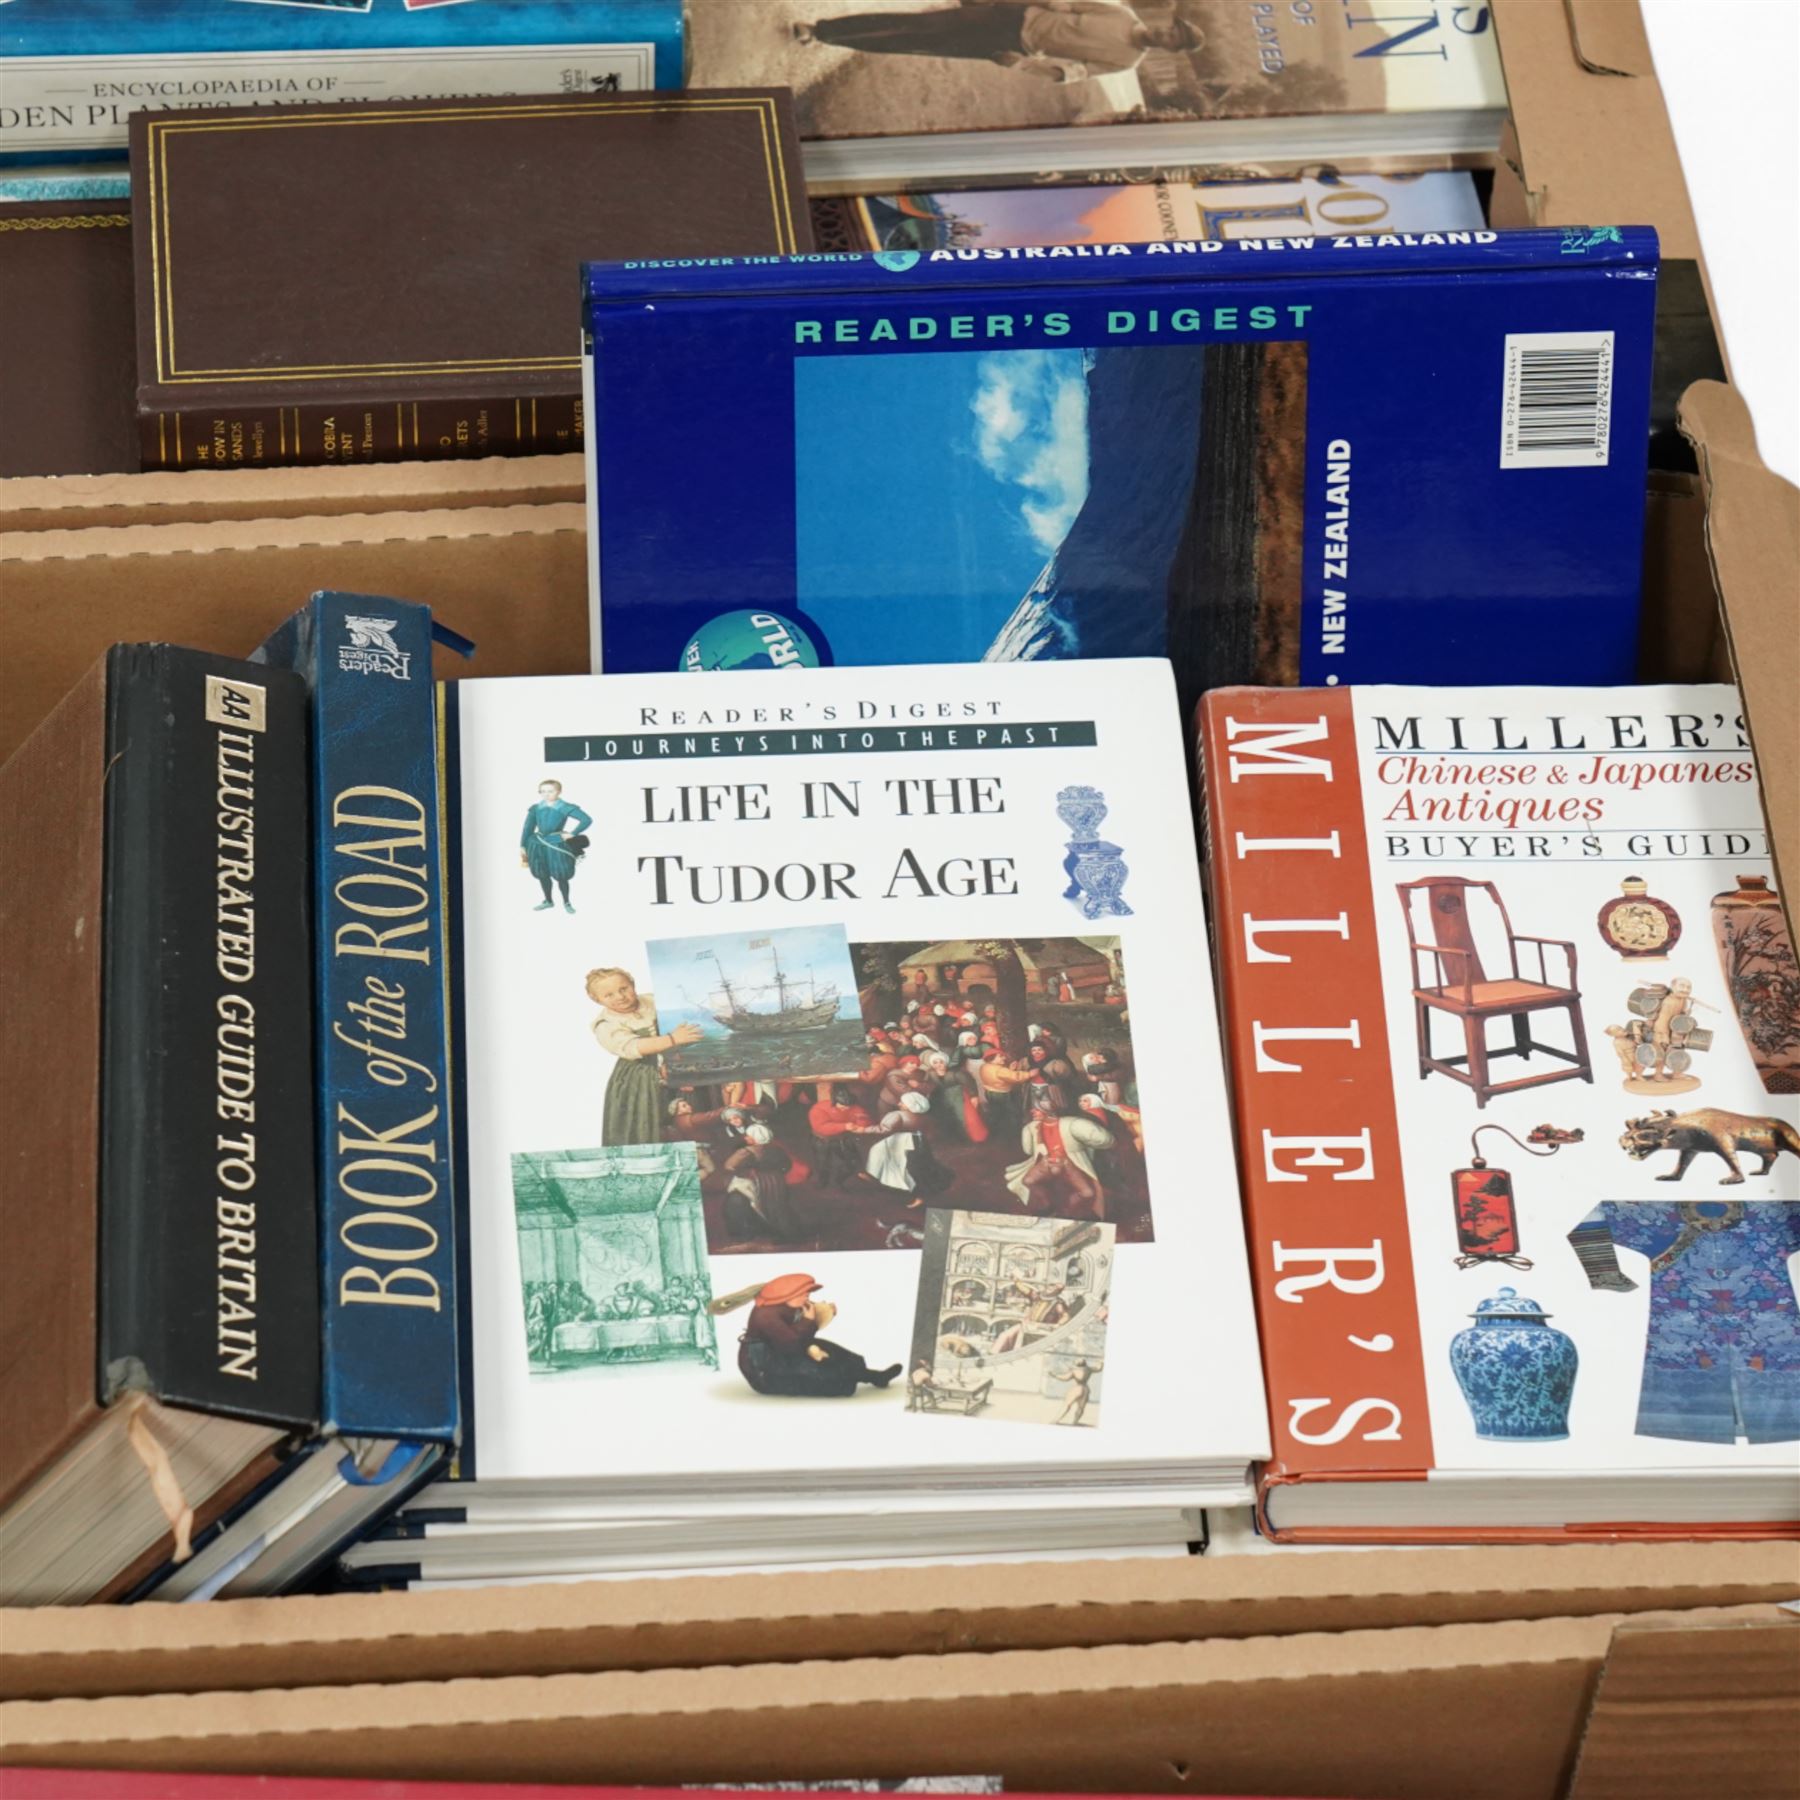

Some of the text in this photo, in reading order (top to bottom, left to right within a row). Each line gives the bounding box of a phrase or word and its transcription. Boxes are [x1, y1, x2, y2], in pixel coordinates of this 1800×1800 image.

[1252, 3, 1285, 74] PLAYED
[93, 75, 339, 98] ENCYCLOPAEDIA OF
[624, 231, 1499, 271] DISCOVER THE WORLD AUSTRALIA AND NEW ZEALAND
[794, 305, 1313, 344] READER'S DIGEST
[1321, 438, 1351, 654] NEW ZEALAND
[583, 726, 1061, 761] JOURNEYS INTO THE PAST
[640, 776, 1006, 824] LIFE IN THE
[1377, 755, 1754, 791] Chinese & Japanes
[1382, 789, 1605, 829] Antiques
[216, 729, 256, 984] ILLUSTRATED
[1385, 833, 1771, 859] BUYER'S GUID
[216, 994, 256, 1124] GUIDE
[333, 784, 441, 1313] BOOK of the ROAD
[1225, 714, 1402, 1446] MILLER'S
[216, 1132, 257, 1192] TO
[216, 1196, 258, 1381] BRITAIN
